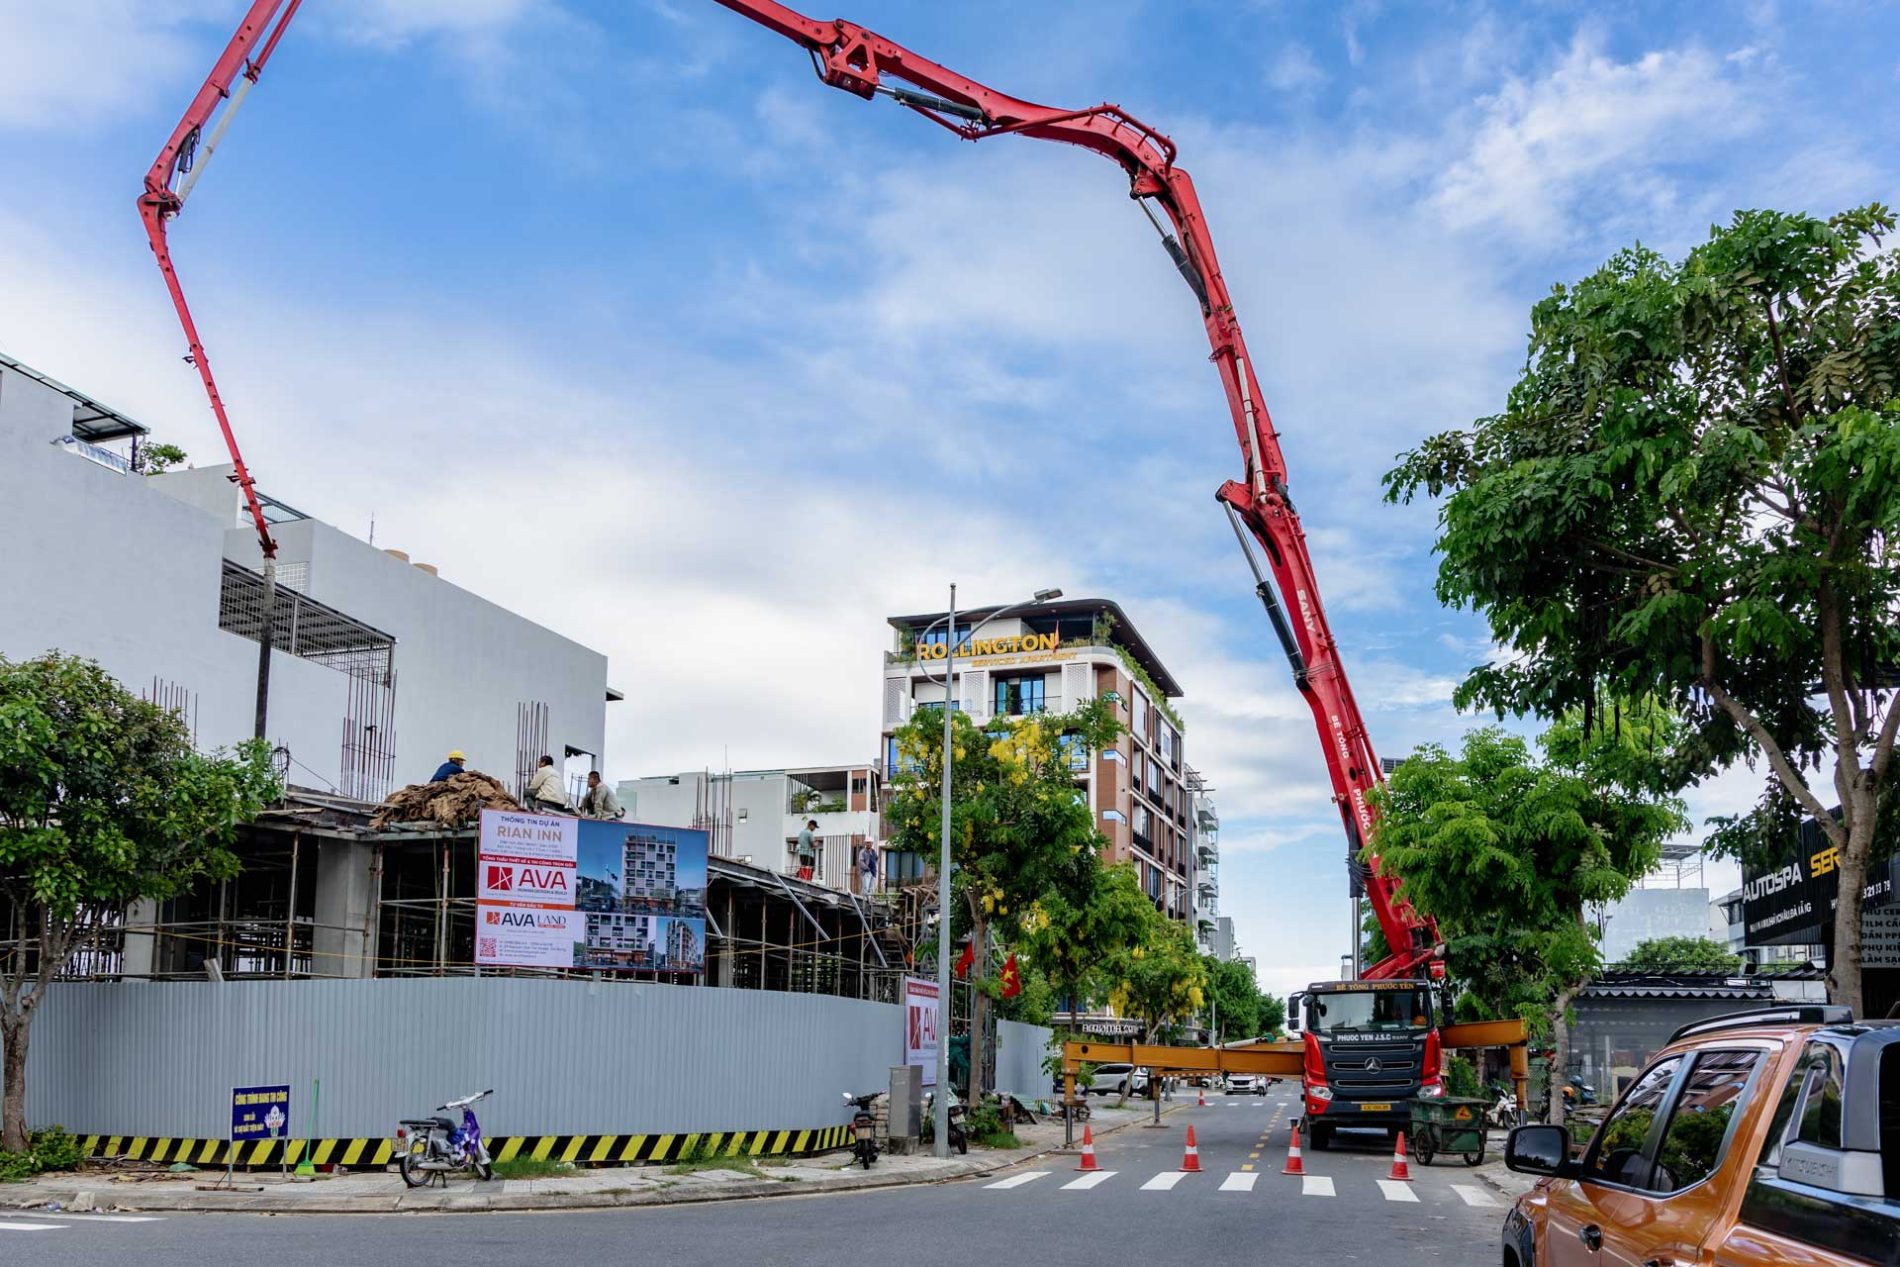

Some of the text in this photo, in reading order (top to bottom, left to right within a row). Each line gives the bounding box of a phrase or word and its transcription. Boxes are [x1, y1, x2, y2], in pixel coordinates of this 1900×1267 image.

[1297, 589, 1316, 632] SANY
[918, 633, 1056, 660] ROLINGTON
[501, 816, 525, 824] THÔNG
[550, 819, 560, 827] ÁN
[497, 826, 562, 842] RIAN INN
[518, 868, 567, 890] AVA
[1742, 847, 1841, 904] AUTOSPA SER
[501, 912, 535, 927] AVA
[537, 915, 567, 925] LAND
[1885, 917, 1900, 927] CÁ
[1861, 945, 1883, 953] PHỤ
[1861, 953, 1900, 966] LÀM SẠ
[923, 1007, 938, 1041] AV
[1360, 1033, 1374, 1041] YEN
[1375, 1033, 1391, 1041] J.S.C
